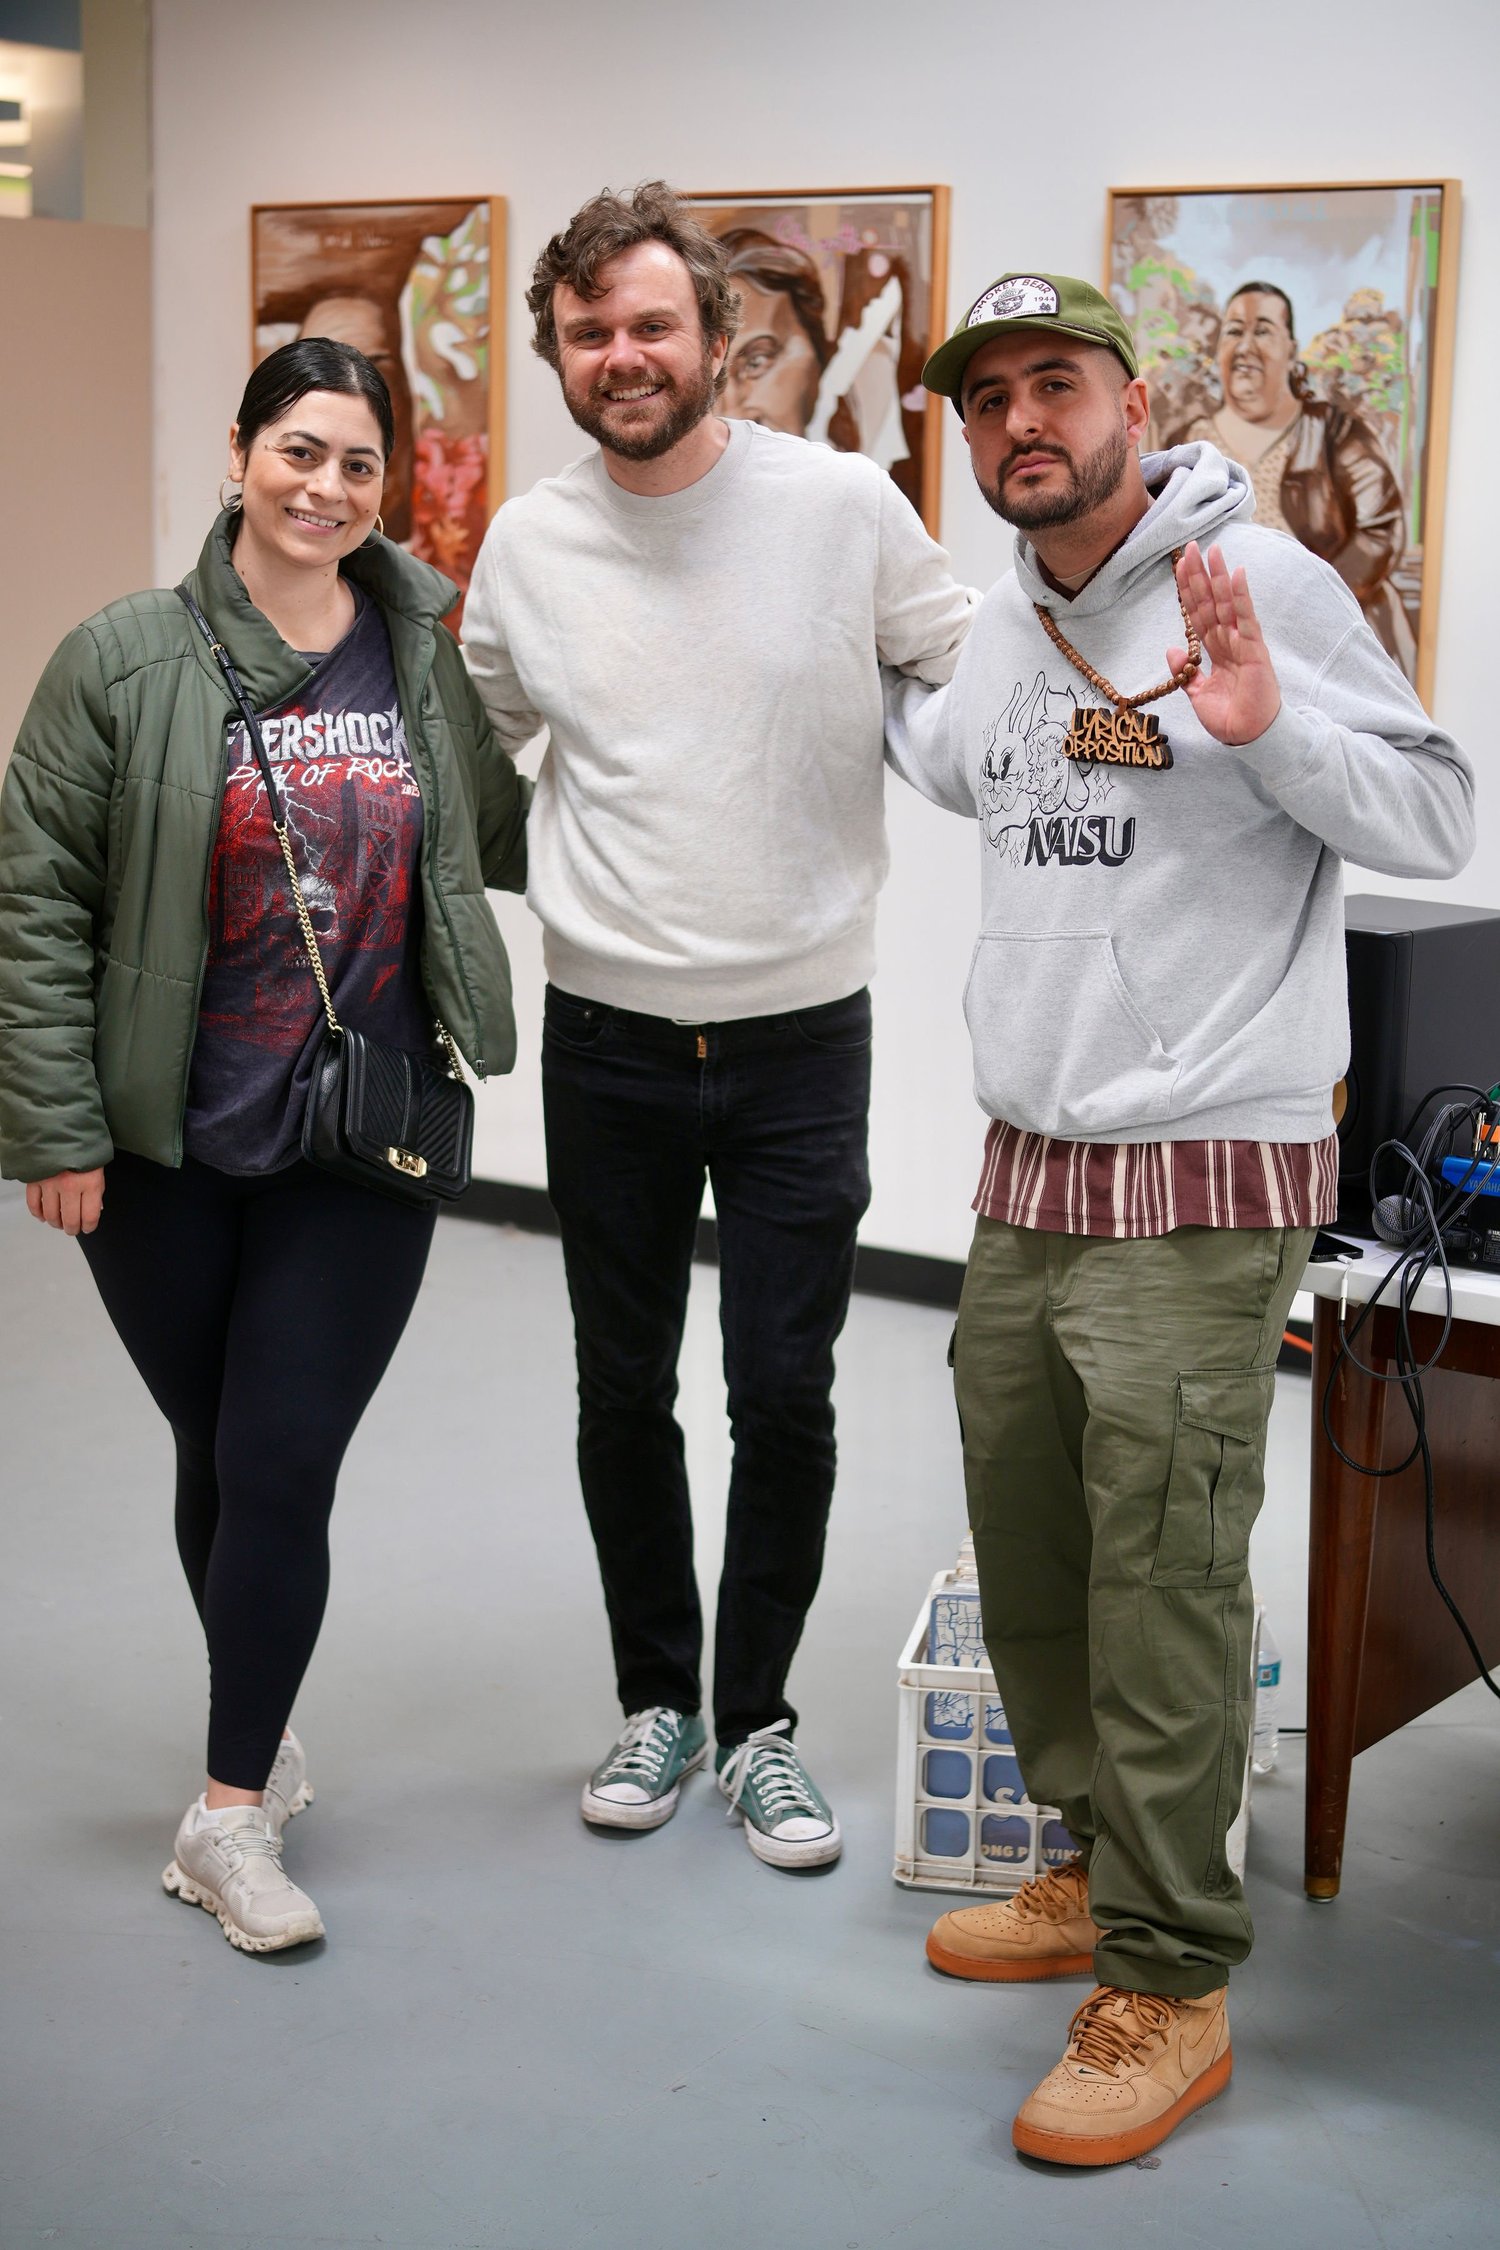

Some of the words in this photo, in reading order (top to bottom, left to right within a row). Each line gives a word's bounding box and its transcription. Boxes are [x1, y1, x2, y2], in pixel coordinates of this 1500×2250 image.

[973, 279, 1018, 315] SMOKEY
[1022, 279, 1052, 294] BEAR
[227, 701, 411, 765] TERSHOCK
[1070, 710, 1158, 744] LYRICAL
[1062, 736, 1162, 766] OPPOSITION
[301, 762, 342, 787] OF
[346, 757, 418, 786] ROCK
[1024, 816, 1136, 867] NAISU
[1469, 1179, 1500, 1193] YAAH
[981, 1843, 1014, 1858] ONG
